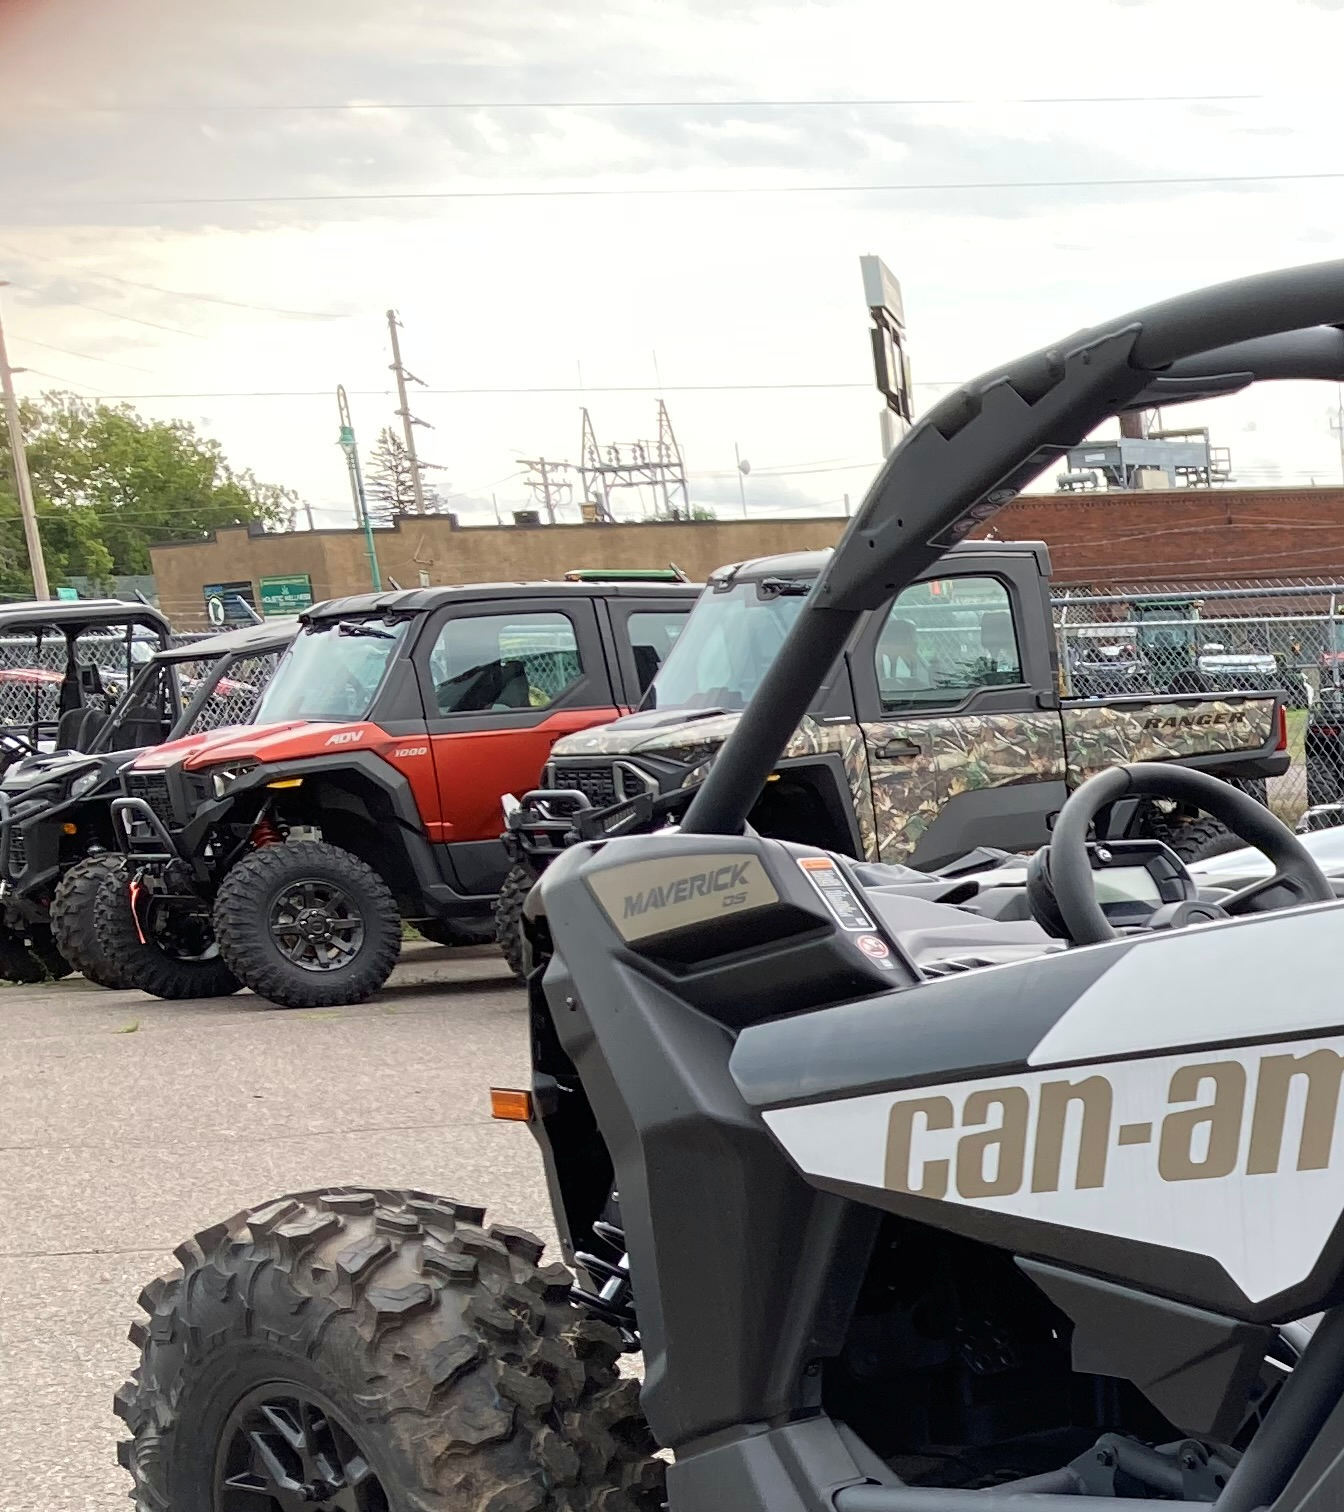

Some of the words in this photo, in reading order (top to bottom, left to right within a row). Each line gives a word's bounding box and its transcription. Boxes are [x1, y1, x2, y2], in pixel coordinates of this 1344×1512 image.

[1143, 711, 1247, 730] RANGER
[324, 729, 365, 747] ADV
[394, 746, 429, 758] 1000
[623, 861, 751, 919] MAVERICK
[721, 891, 748, 908] DS
